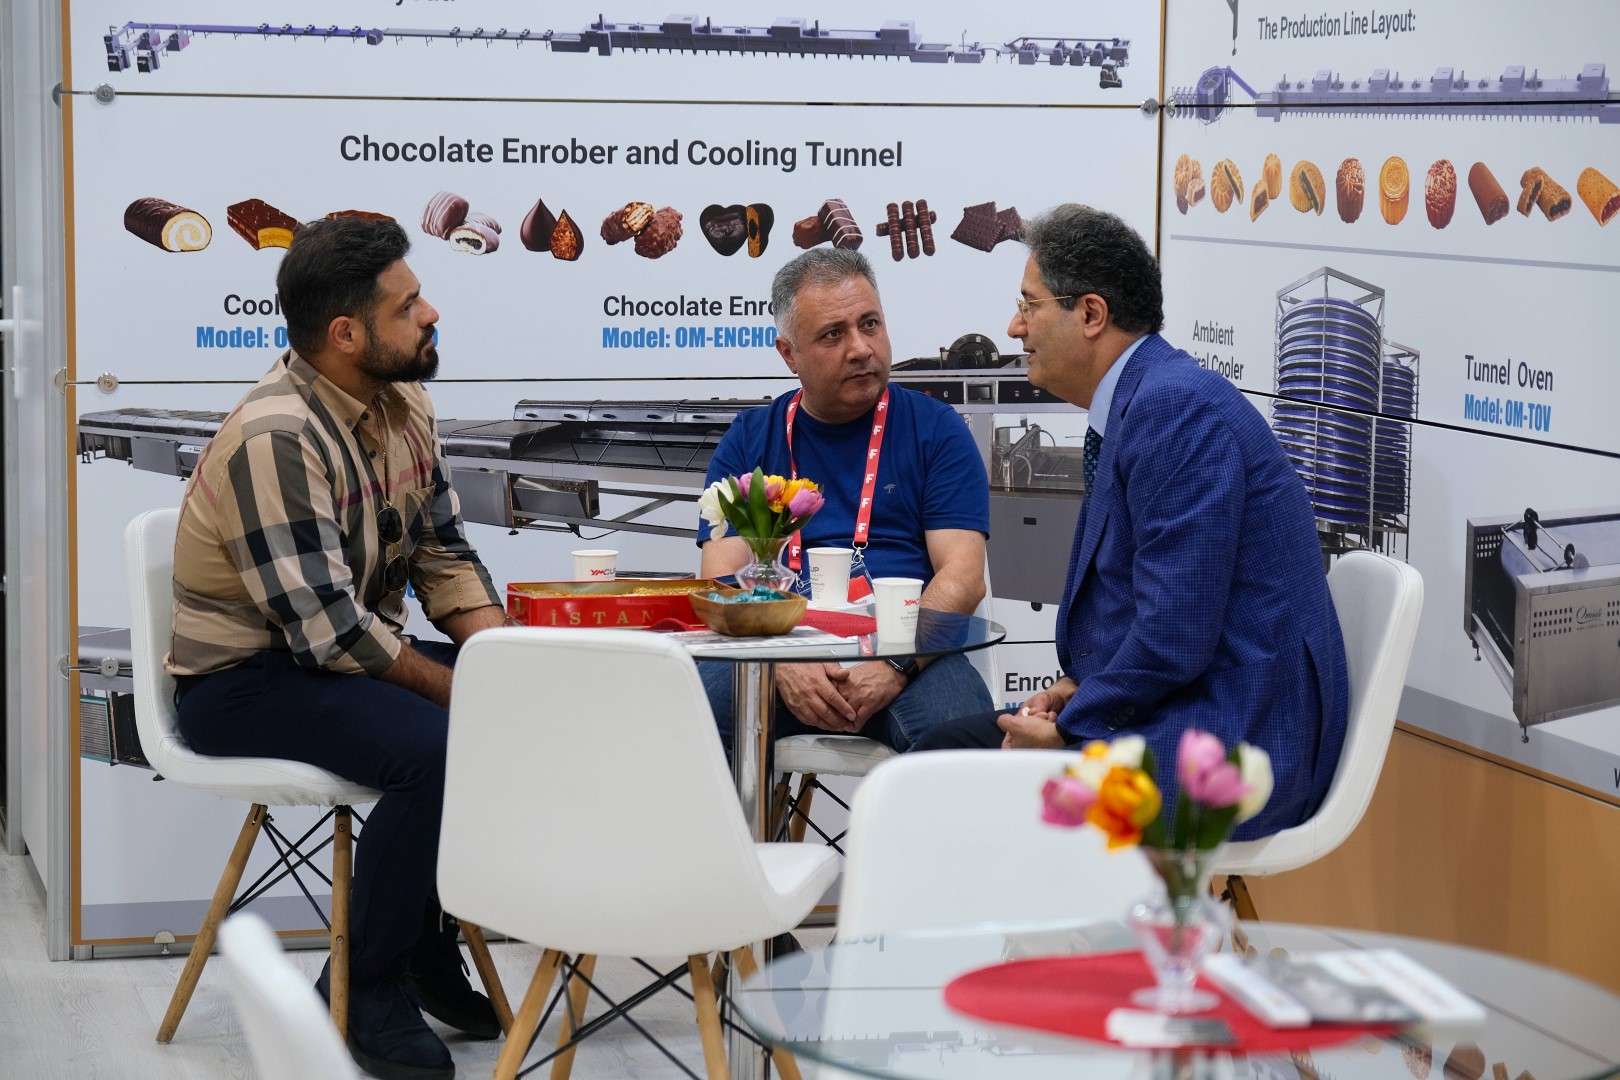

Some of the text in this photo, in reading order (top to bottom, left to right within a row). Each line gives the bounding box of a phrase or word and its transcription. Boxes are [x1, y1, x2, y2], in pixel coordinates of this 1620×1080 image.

[1258, 9, 1417, 40] The Production Line Layout:
[340, 134, 903, 173] Chocolate Enrober and Cooling Tunnel
[603, 295, 723, 317] Chocolate
[196, 326, 270, 348] Model:
[602, 327, 671, 348] Model:
[1192, 320, 1234, 346] Ambient
[1211, 354, 1244, 380] Cooler
[1465, 354, 1553, 392] Tunnel Oven
[1464, 393, 1552, 432] Model: OM-TOV
